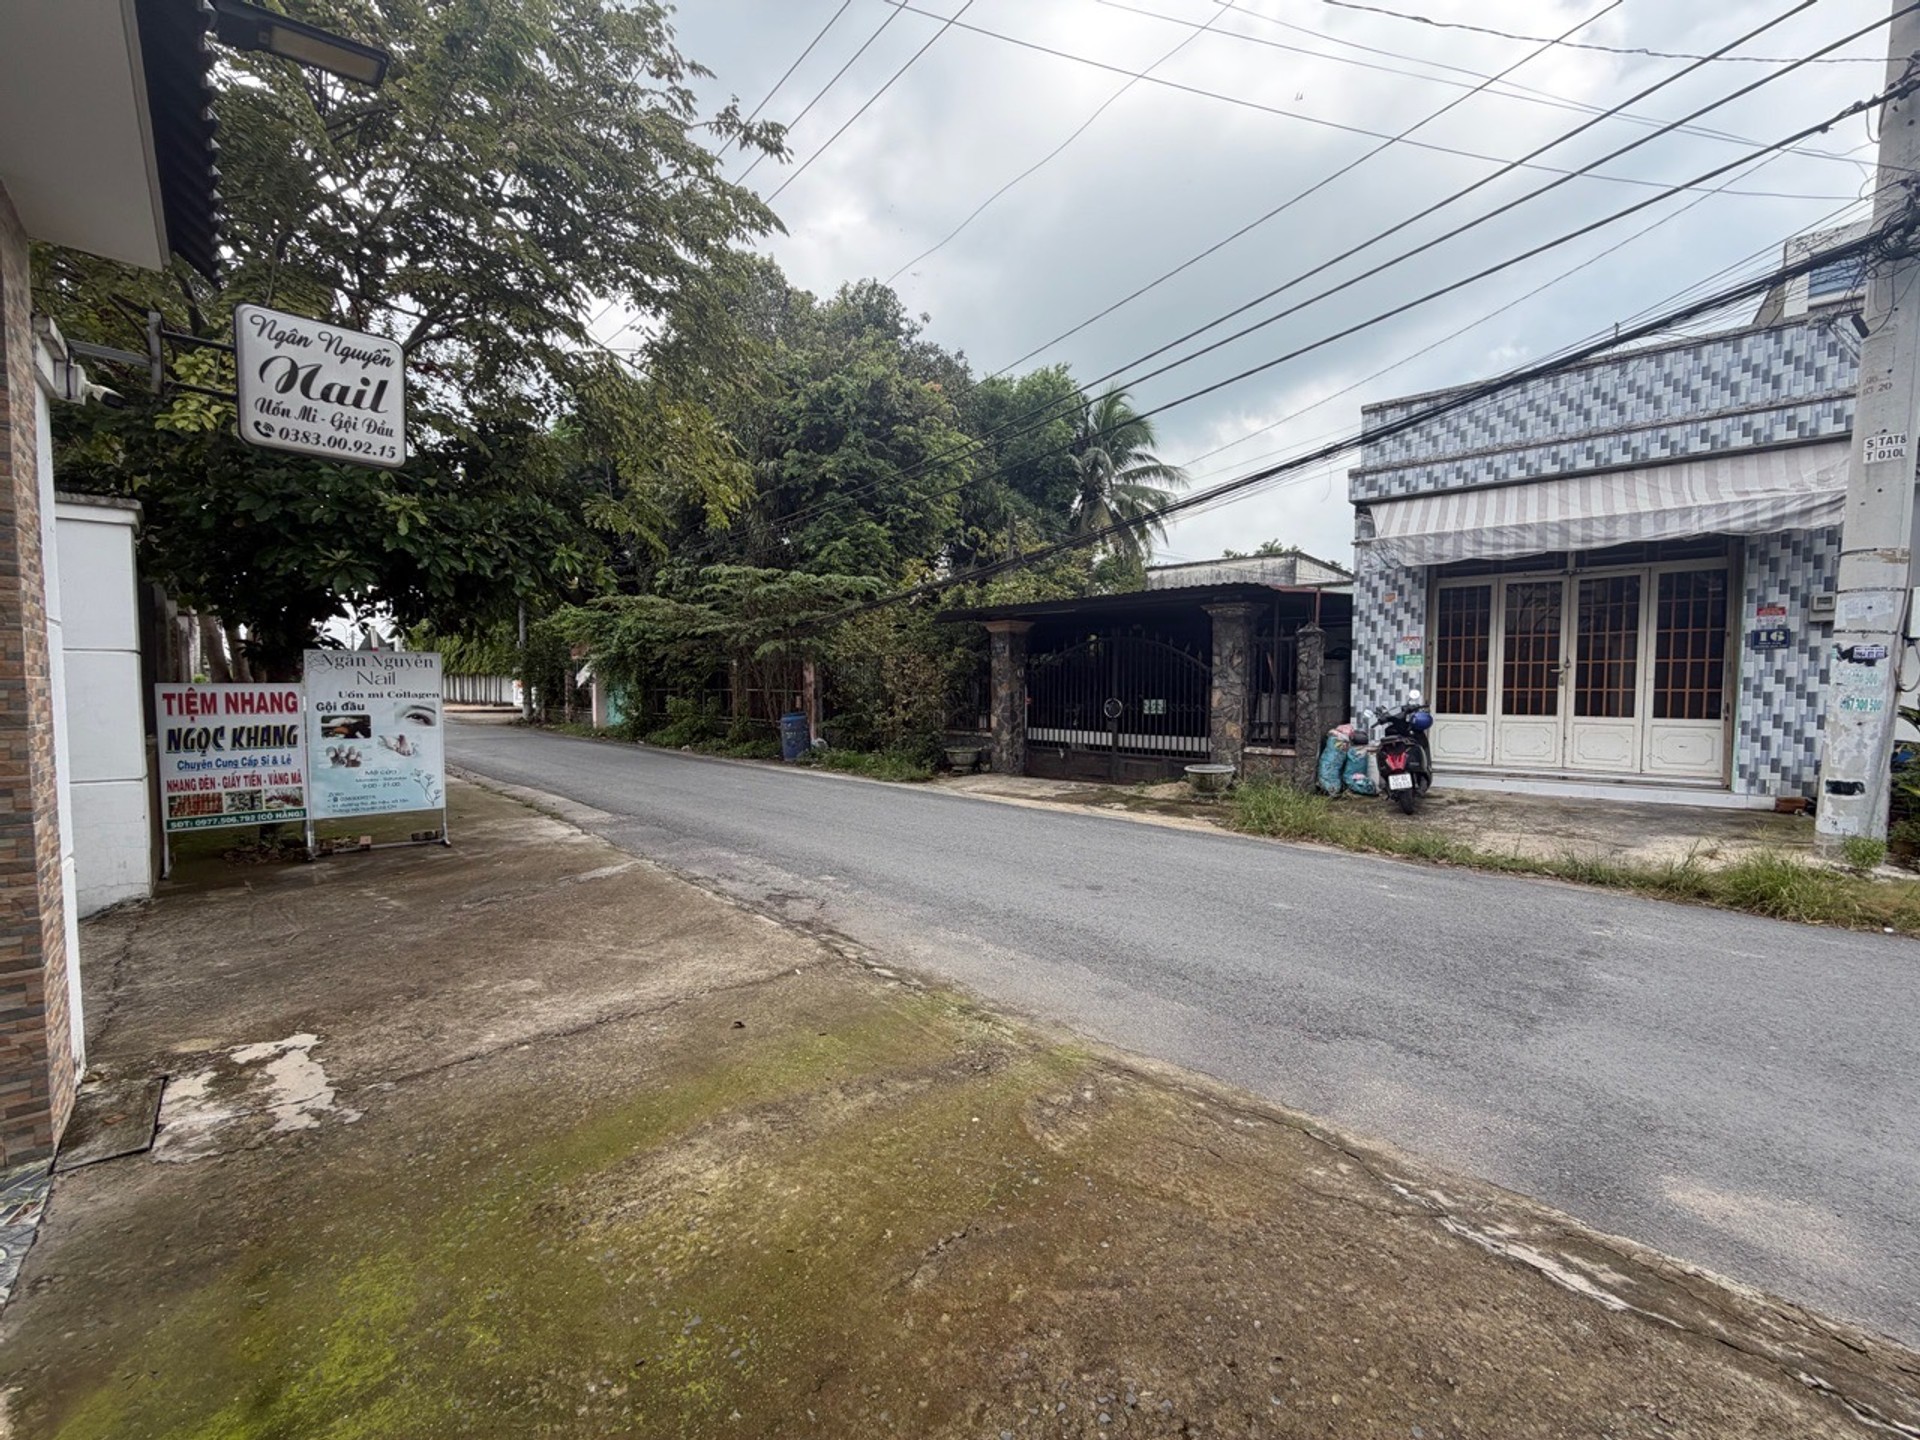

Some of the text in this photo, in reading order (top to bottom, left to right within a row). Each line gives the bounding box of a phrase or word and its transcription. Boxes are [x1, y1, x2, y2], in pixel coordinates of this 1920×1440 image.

[250, 314, 394, 370] Ngân Nguyễn
[259, 355, 389, 414] Nail
[254, 397, 291, 418] Uốn
[294, 405, 318, 424] Mi
[330, 411, 359, 433] Gội
[279, 427, 396, 458] 0383.00.92.15
[1760, 631, 1785, 642] 16
[322, 653, 366, 670] Ngân
[356, 671, 396, 685] Nail
[162, 687, 298, 722] TIỆM NHANG
[387, 690, 440, 700] Collagen
[316, 702, 337, 713] Gội
[166, 724, 299, 756] NGỌC KHANG
[177, 759, 213, 771] Chuyên
[215, 758, 239, 769] Cung
[241, 754, 258, 769] Cấp
[166, 778, 197, 792] NHANG
[222, 770, 241, 789] GIẤY
